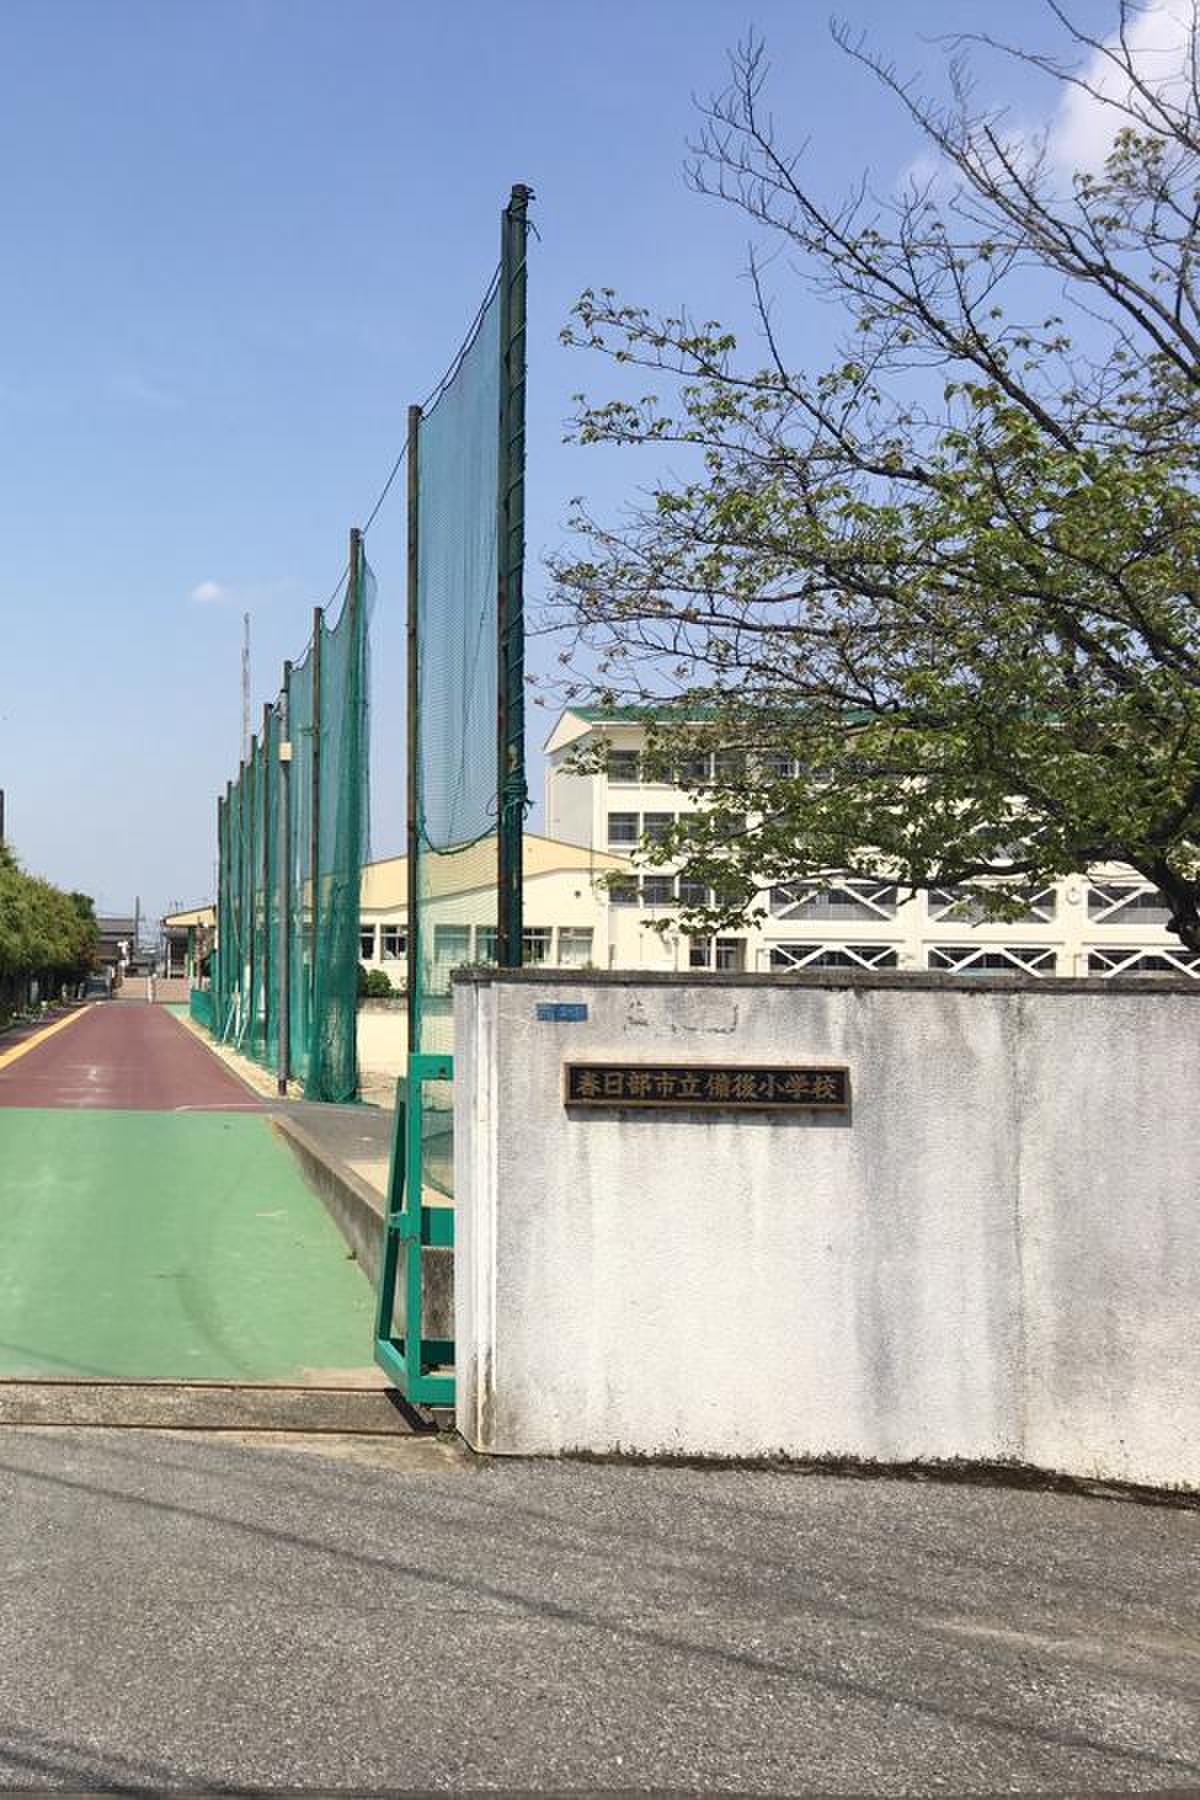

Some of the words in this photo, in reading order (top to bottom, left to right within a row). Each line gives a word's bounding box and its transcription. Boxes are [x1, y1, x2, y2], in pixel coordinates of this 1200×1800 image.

[576, 1071, 838, 1100] 春日部市立備後小学校
